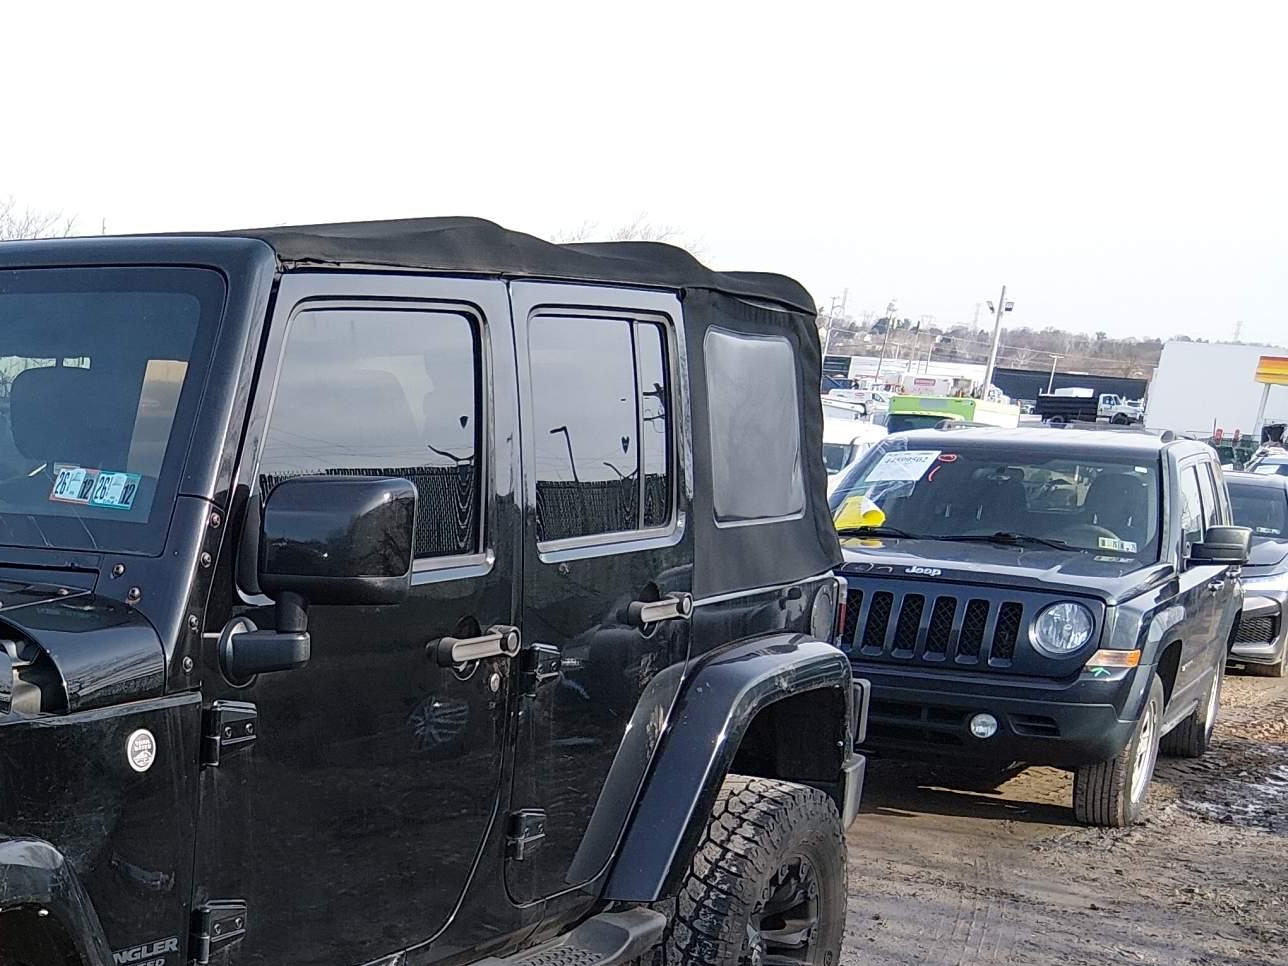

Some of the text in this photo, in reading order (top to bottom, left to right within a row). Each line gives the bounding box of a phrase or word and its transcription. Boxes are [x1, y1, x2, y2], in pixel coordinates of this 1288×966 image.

[77, 479, 95, 499] 12
[118, 483, 136, 505] 12
[905, 565, 942, 577] Jeep
[112, 937, 178, 966] NGLER
